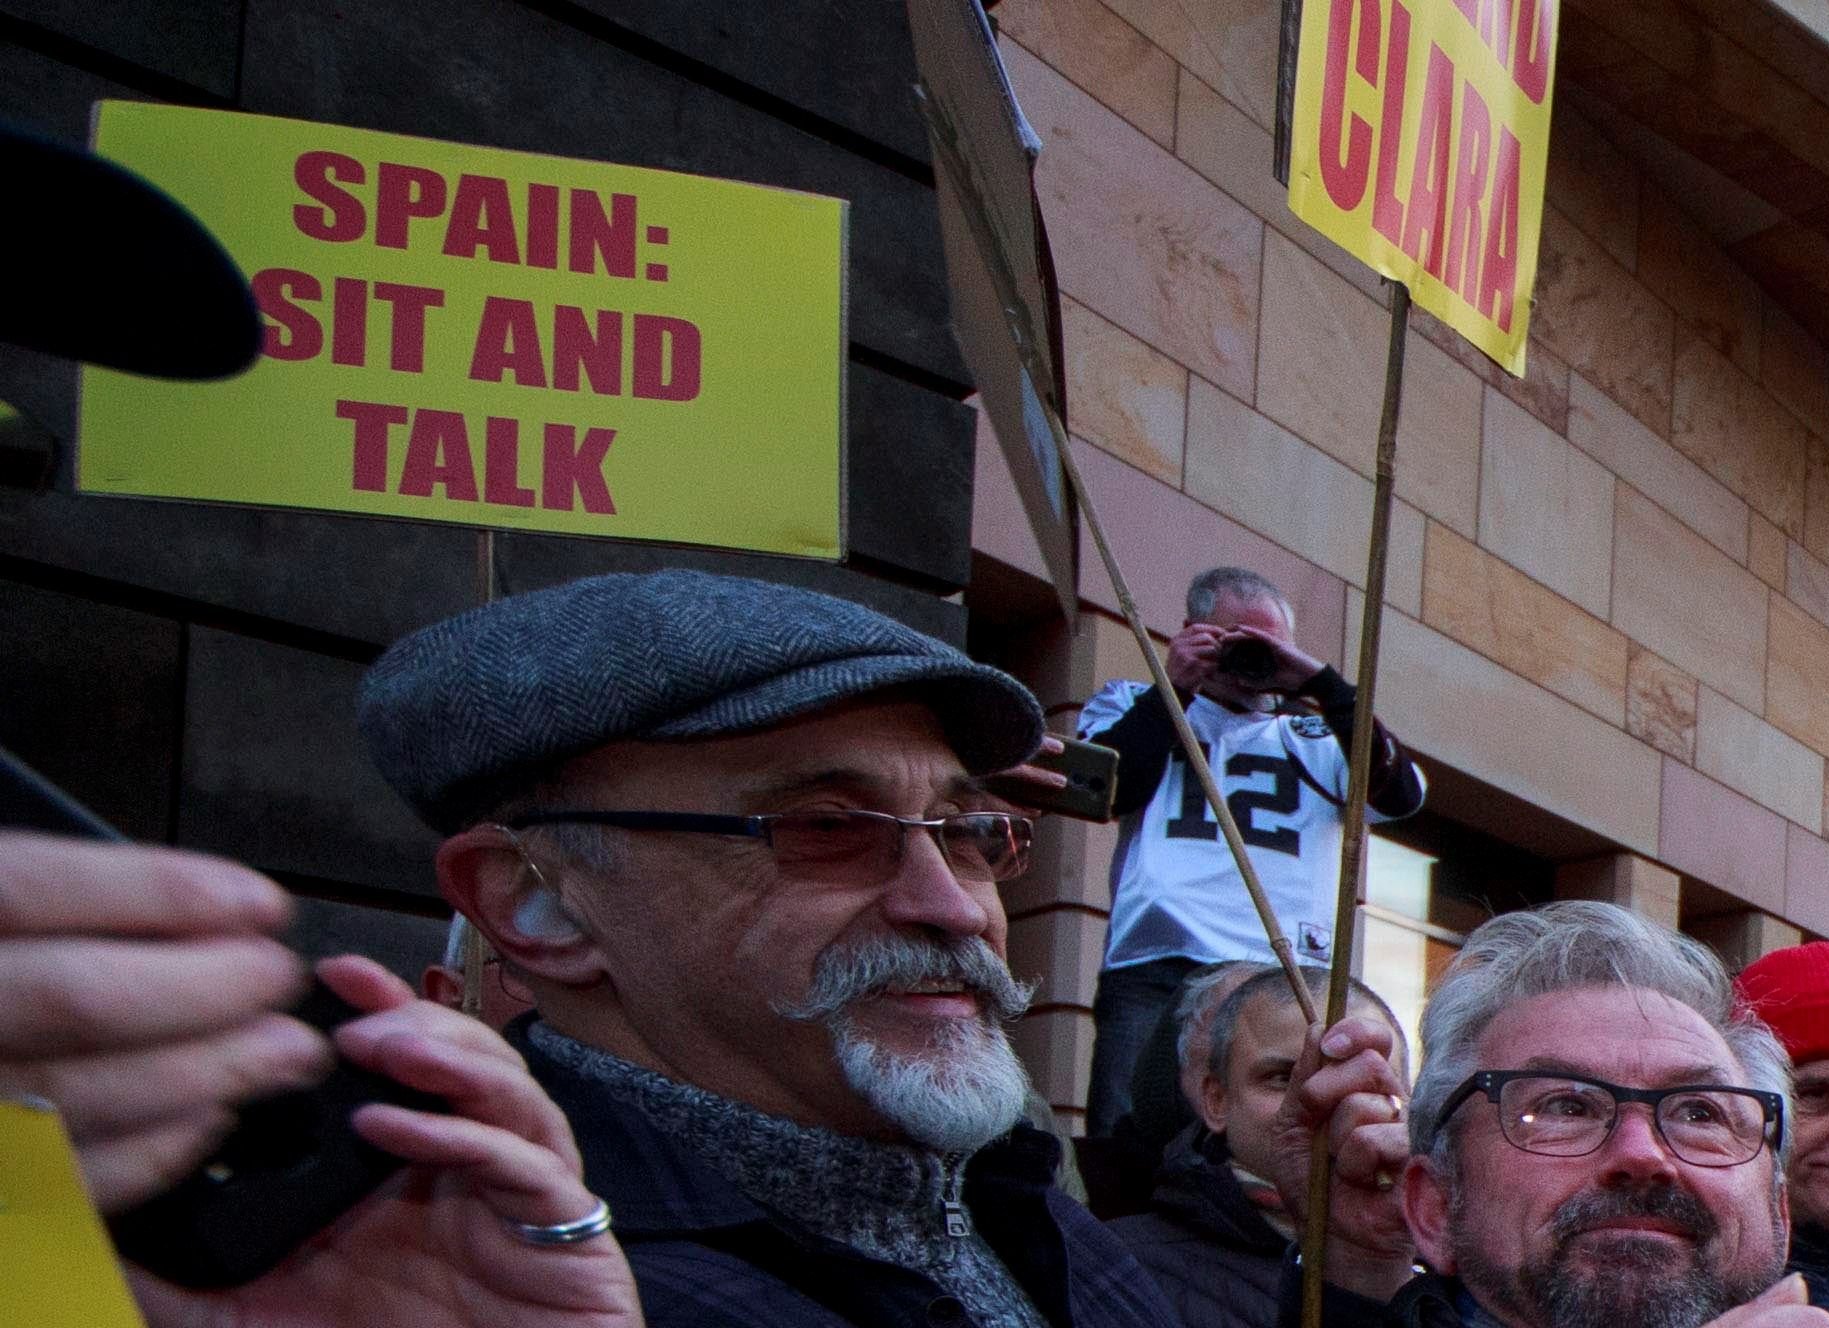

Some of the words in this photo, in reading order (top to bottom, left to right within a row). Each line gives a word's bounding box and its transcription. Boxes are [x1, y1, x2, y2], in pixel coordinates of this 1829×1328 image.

[293, 150, 669, 282] SPAIN:
[1319, 0, 1521, 336] CLARA
[250, 266, 445, 374] SIT
[469, 296, 702, 402] AND
[336, 400, 618, 516] TALK
[1165, 741, 1301, 858] 12
